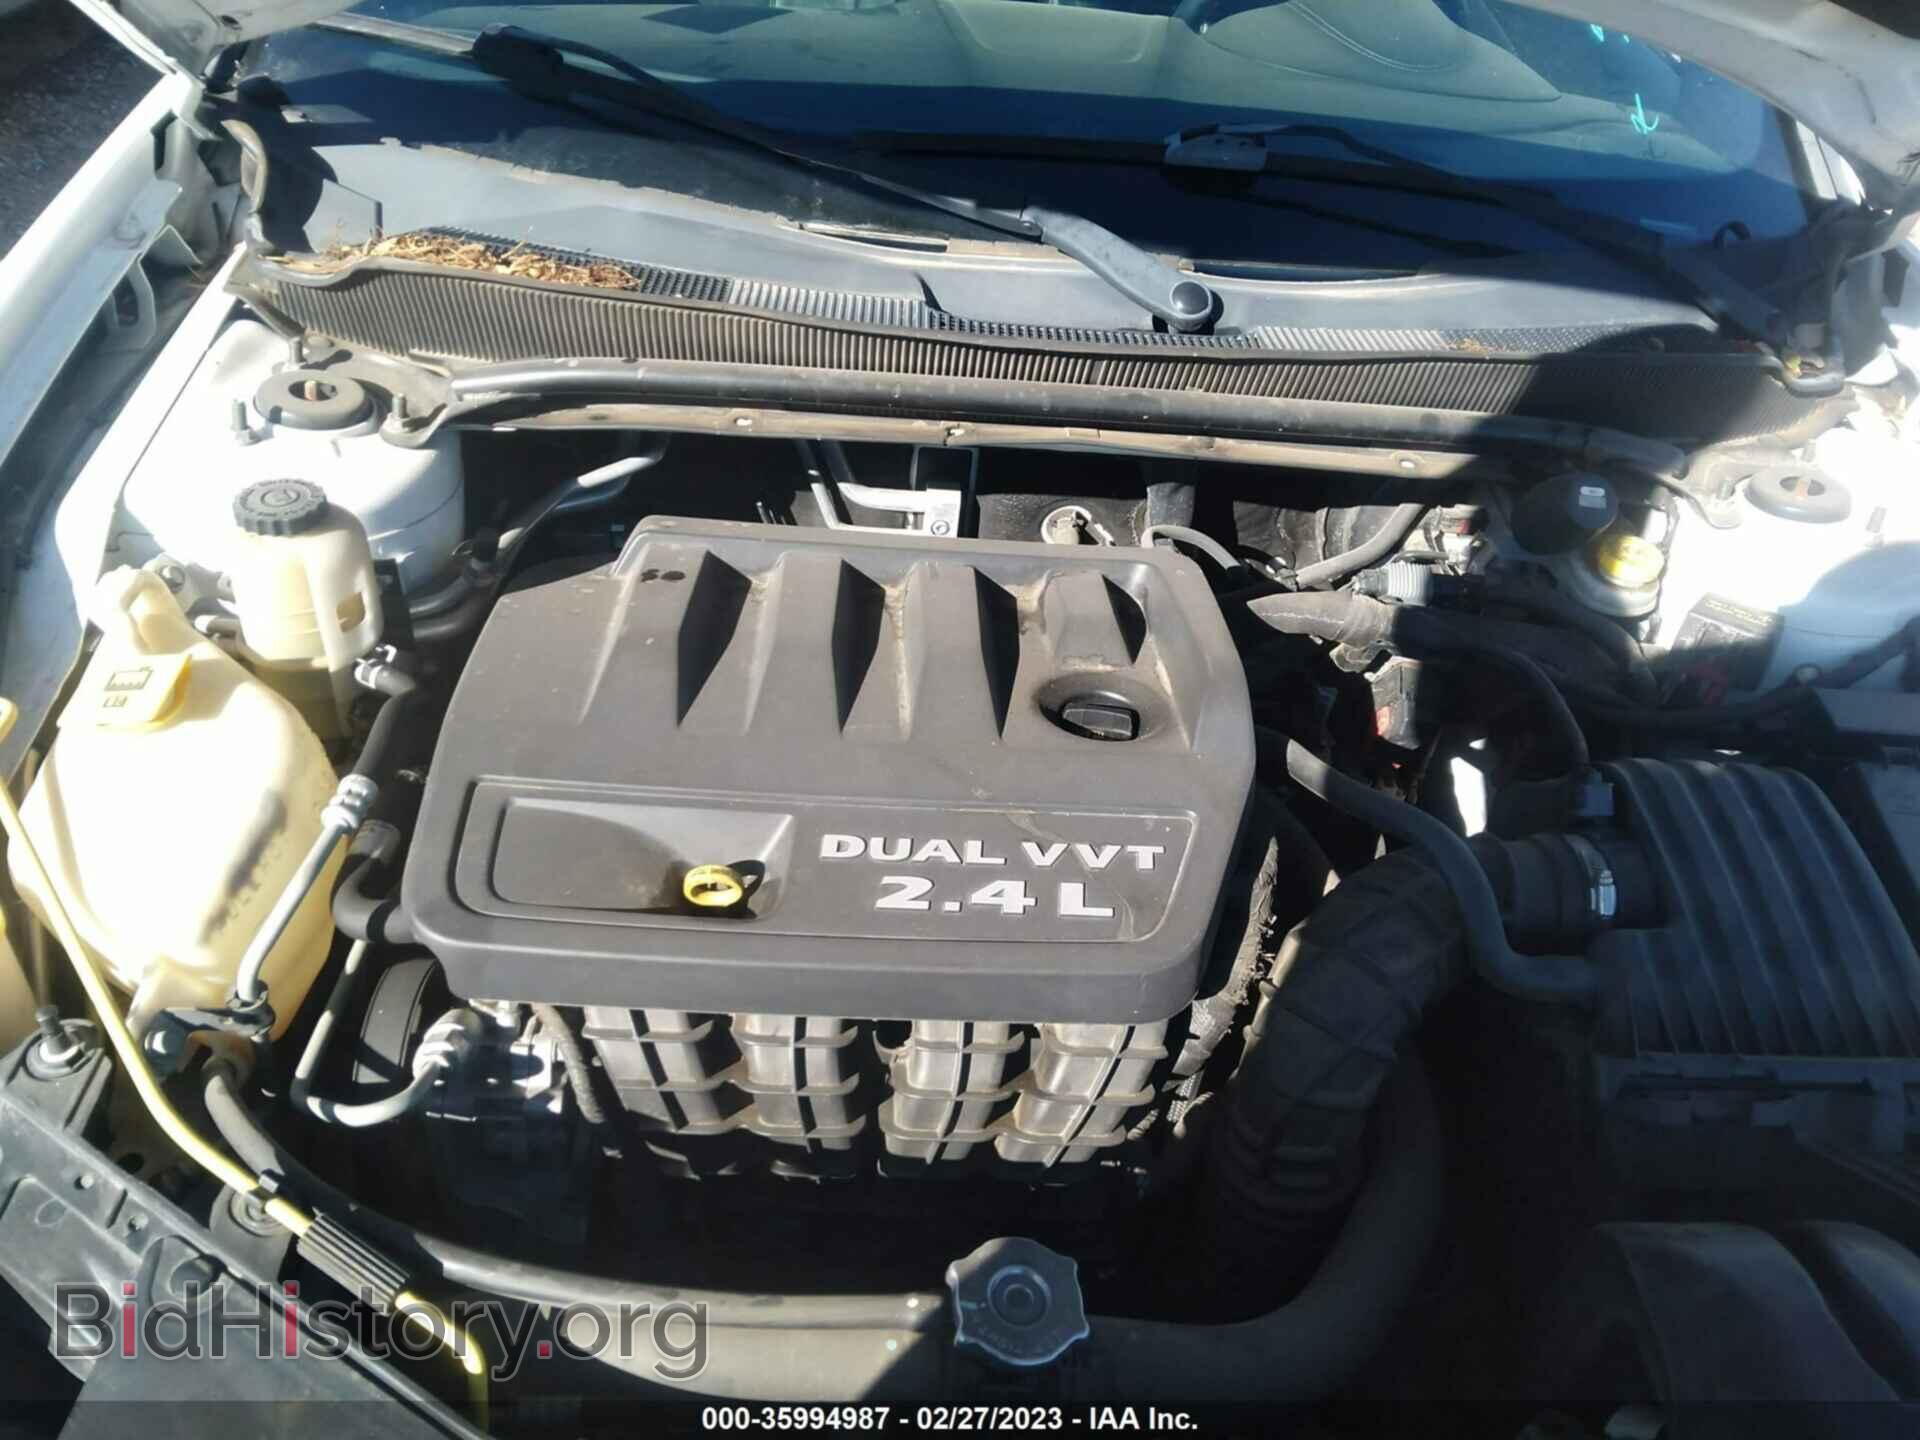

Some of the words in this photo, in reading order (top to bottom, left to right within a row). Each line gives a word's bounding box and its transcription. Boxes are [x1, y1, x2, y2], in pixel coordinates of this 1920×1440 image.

[820, 834, 1006, 865] DUAL
[1022, 841, 1165, 869] VVT
[874, 875, 1038, 915] 2.4
[1058, 881, 1115, 918] L
